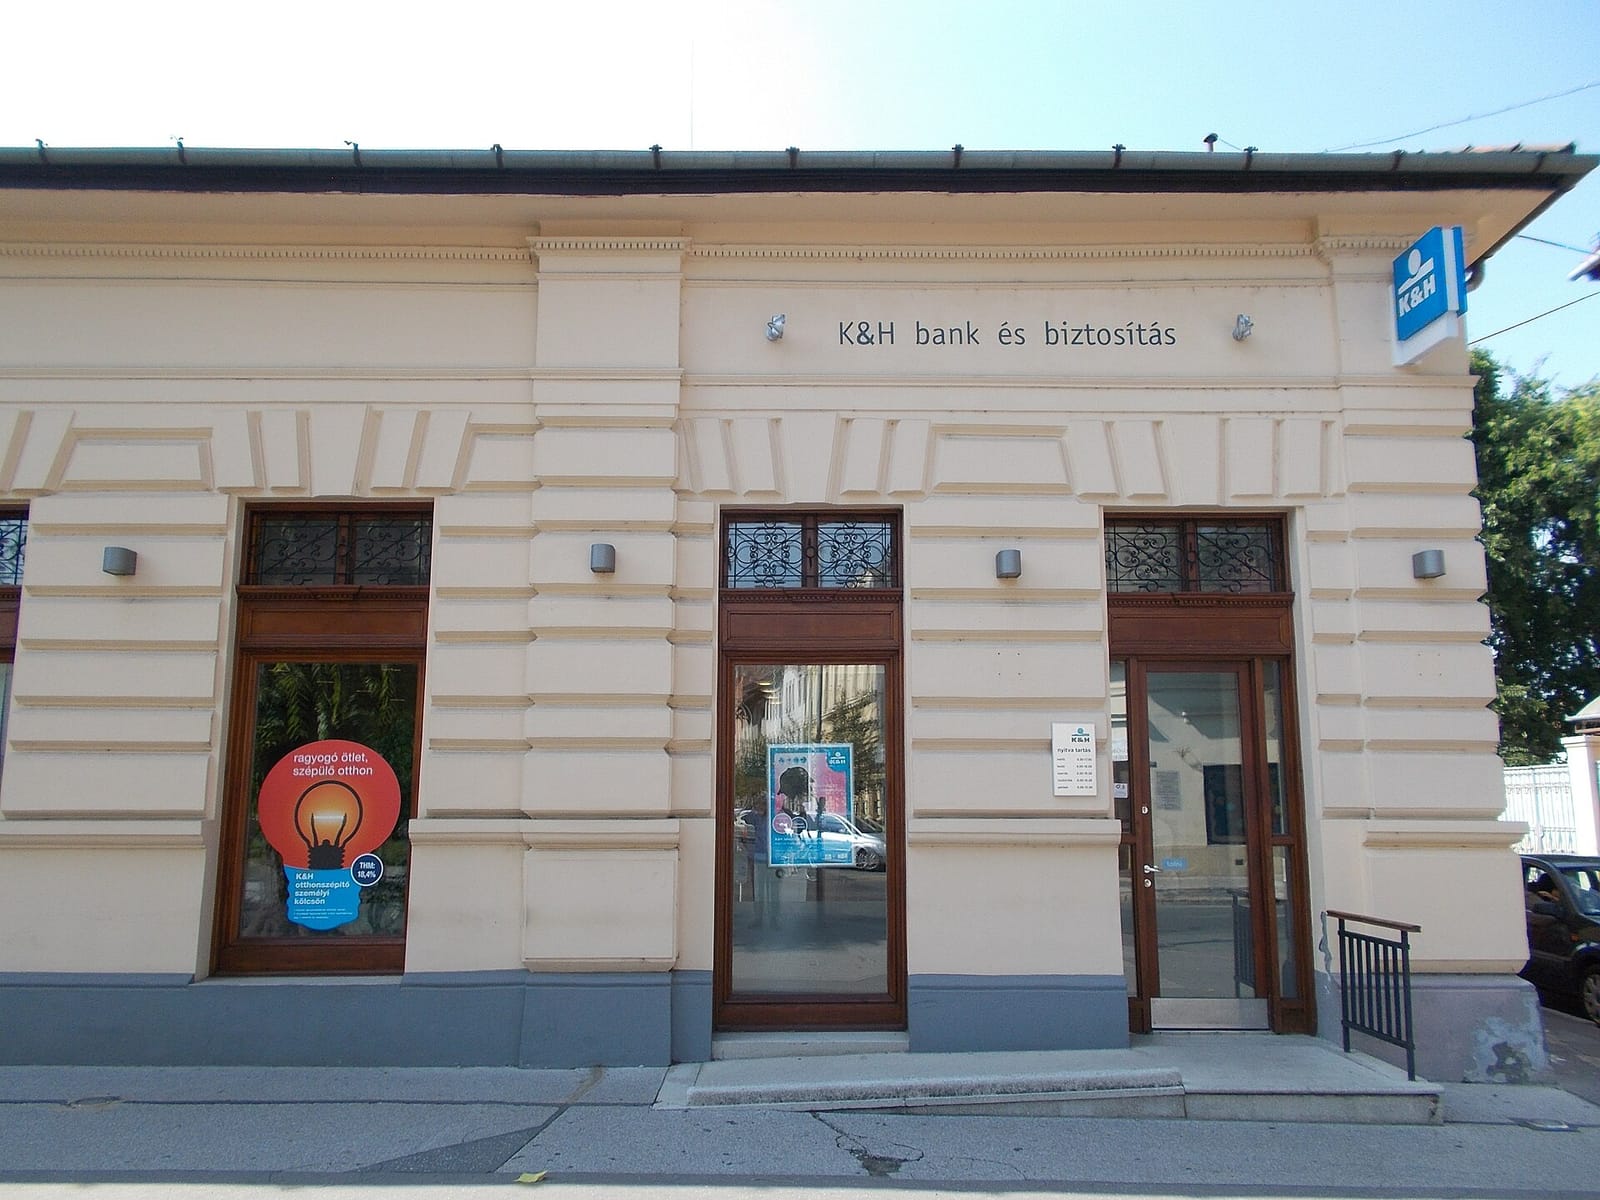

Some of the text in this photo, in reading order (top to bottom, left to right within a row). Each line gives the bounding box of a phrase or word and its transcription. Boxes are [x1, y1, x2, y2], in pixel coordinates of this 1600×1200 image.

[1398, 274, 1436, 317] K&H
[839, 321, 1176, 345] K&H bank és biztosítás
[293, 752, 368, 765] ragyogó ötlet,
[292, 766, 373, 777] szépülő otthon
[360, 861, 376, 869] THM:
[294, 889, 330, 897] személyi
